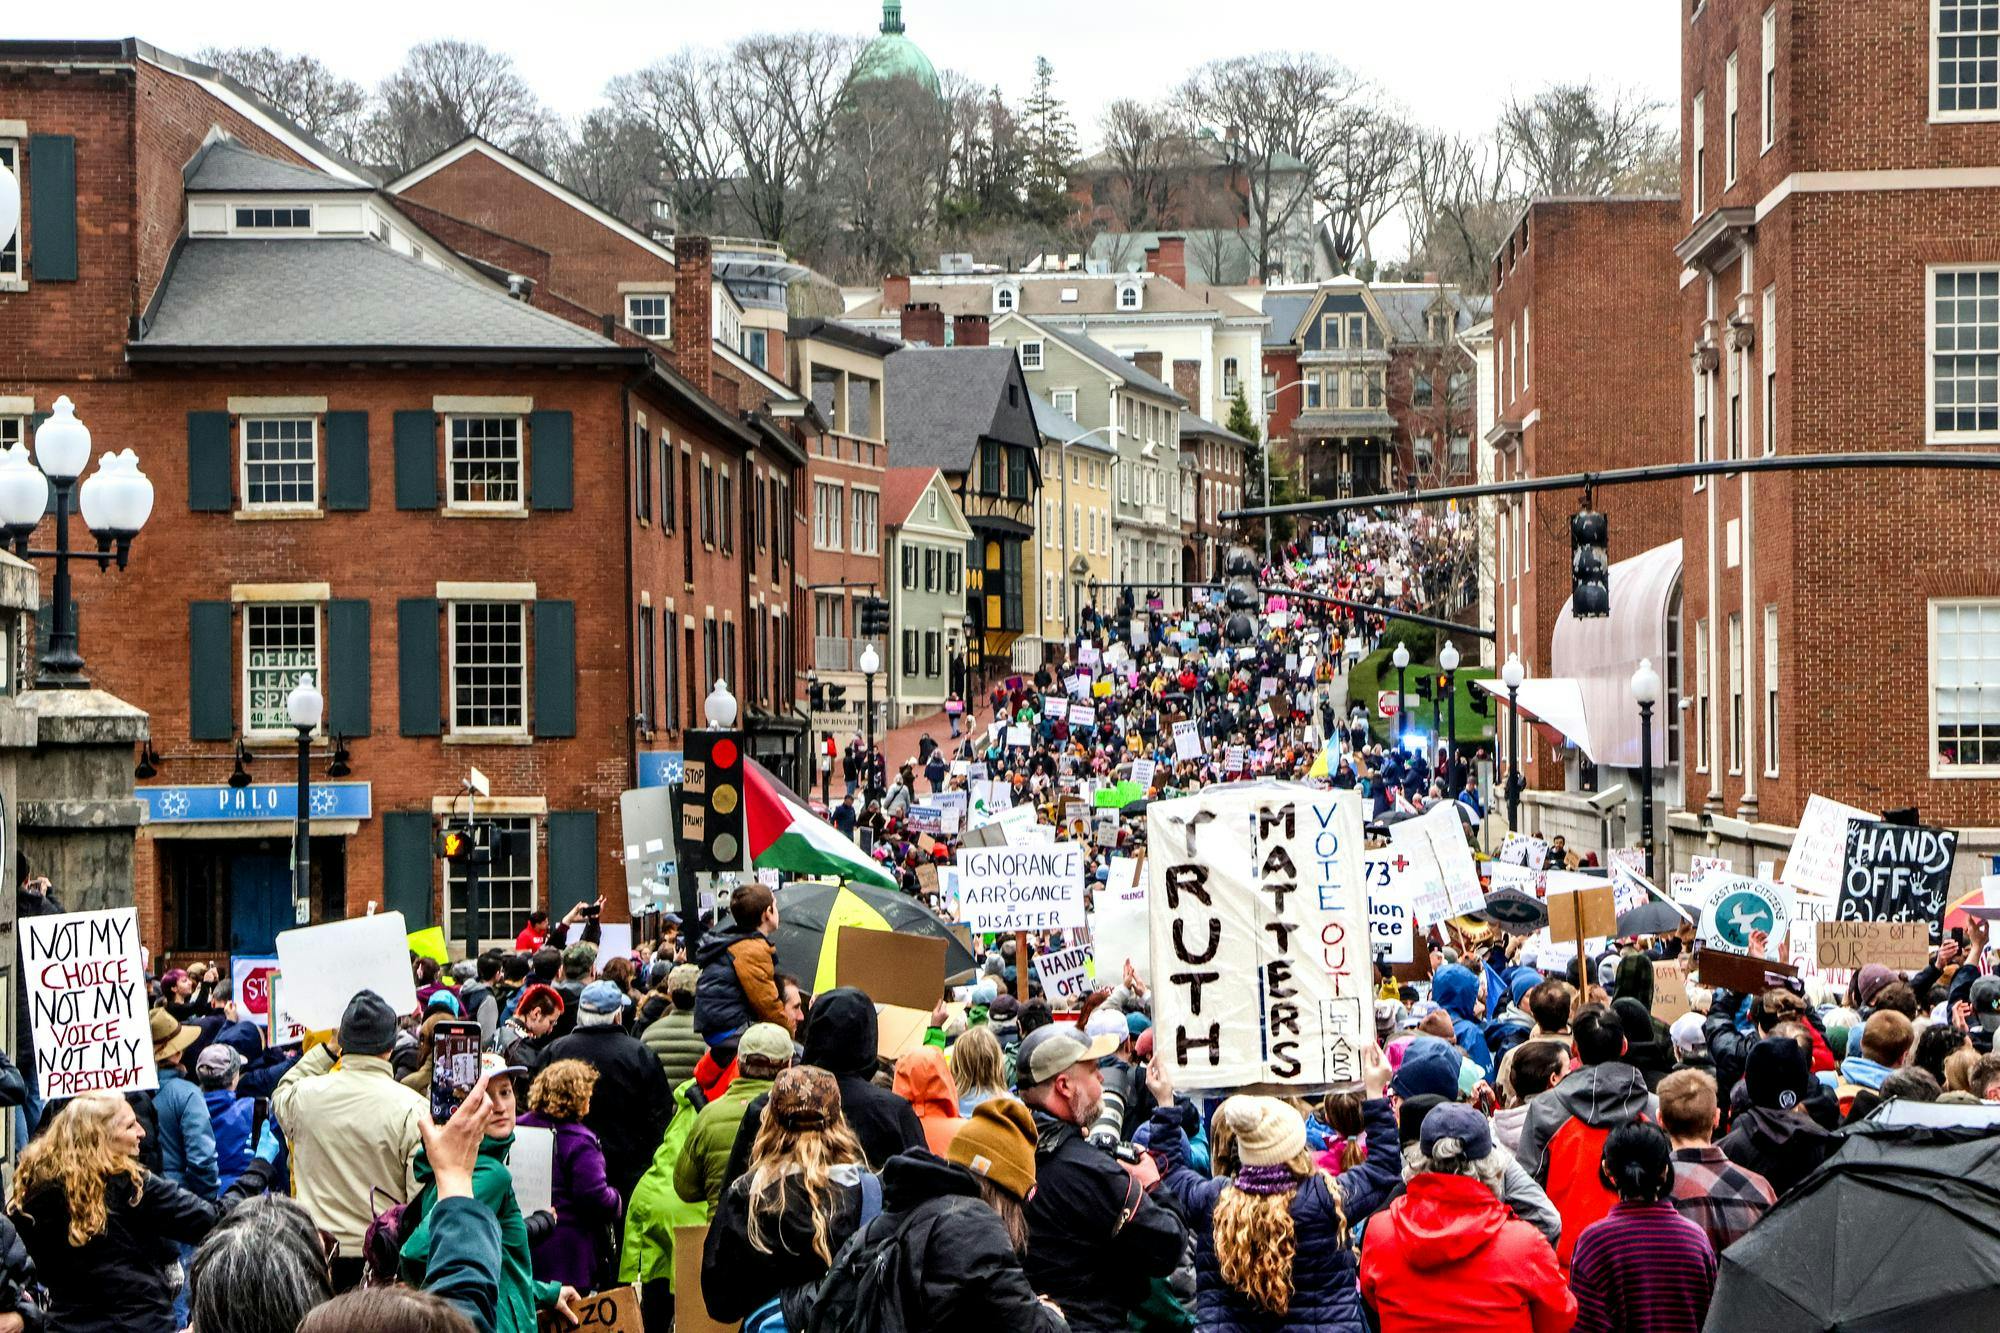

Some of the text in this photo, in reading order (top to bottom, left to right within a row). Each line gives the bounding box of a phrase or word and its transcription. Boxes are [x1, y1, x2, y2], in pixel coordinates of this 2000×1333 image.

[251, 652, 315, 667] OFFICE
[254, 672, 314, 688] LEAS
[254, 692, 289, 709] SPA
[813, 717, 829, 725] NEW
[684, 767, 704, 783] STOP
[219, 788, 277, 811] PALO
[683, 814, 704, 828] TRUMP
[1856, 829, 1955, 874] HANDS
[965, 852, 1078, 878] IGNORANCE
[965, 885, 1073, 904] ARROGANCE
[1846, 866, 1911, 900] OFF
[1312, 803, 1351, 997] VOTE OUT
[1367, 896, 1404, 918] lion
[1709, 881, 1785, 921] EAST BAY CITIZENS
[978, 911, 1060, 928] DISASTER
[1367, 920, 1403, 936] ree
[1840, 899, 1941, 937] Palestie
[30, 917, 131, 962] NOT MY
[1165, 809, 1222, 1066] TRUTH
[1259, 802, 1302, 1078] MATTERS
[1709, 934, 1731, 952] FOR
[1822, 923, 1922, 940] HANDS OFF
[1040, 945, 1094, 977] HANDS
[1818, 941, 1864, 966] OUR
[40, 958, 129, 990] CHOICE
[1056, 973, 1085, 997] OFF
[246, 977, 268, 1000] STO
[34, 982, 136, 1029] NOT MY
[50, 1018, 121, 1048] VOICE
[38, 1038, 141, 1075] NOT MY
[47, 1066, 144, 1097] PRESIDENT
